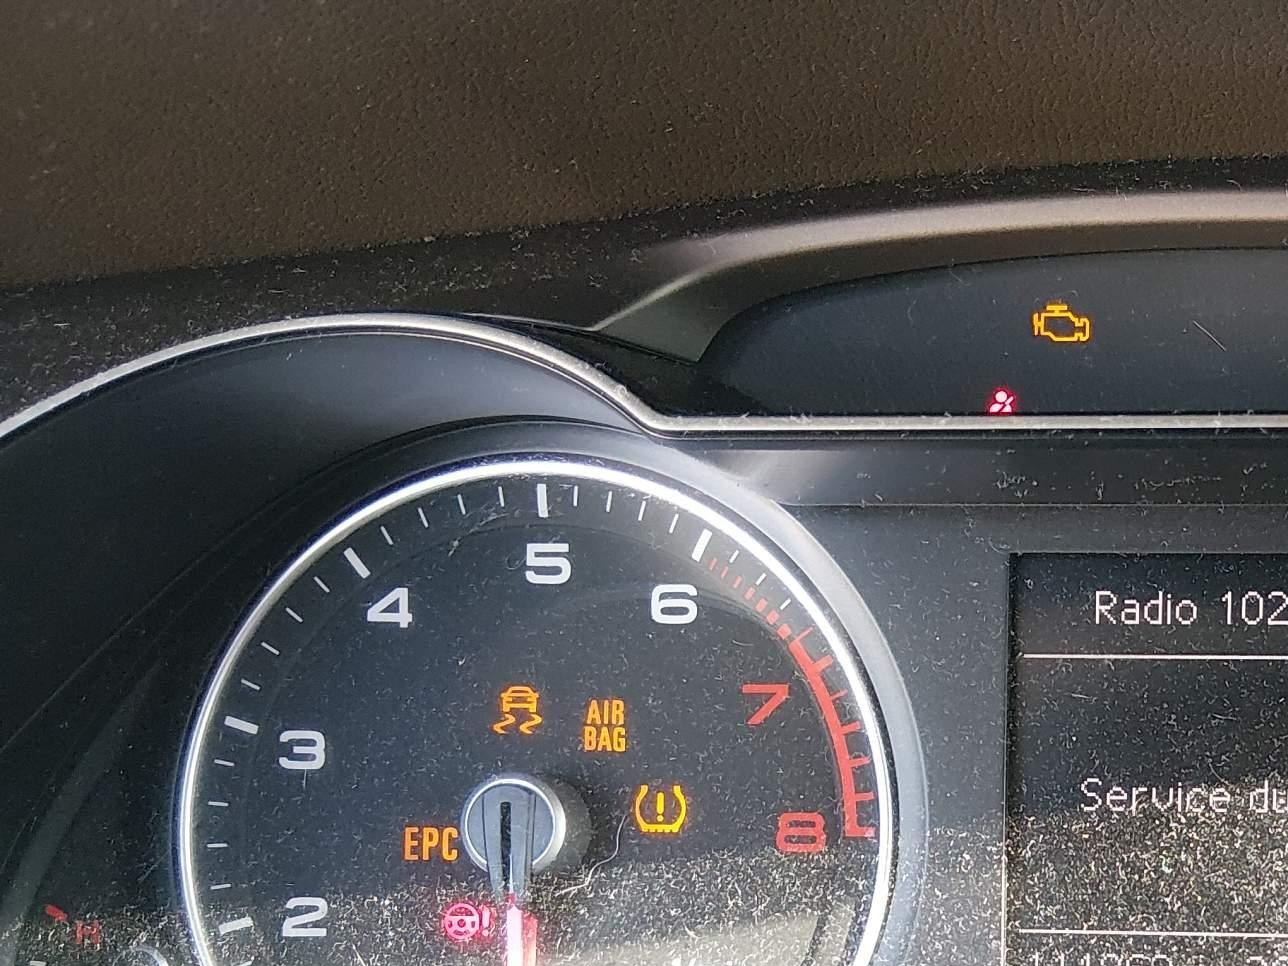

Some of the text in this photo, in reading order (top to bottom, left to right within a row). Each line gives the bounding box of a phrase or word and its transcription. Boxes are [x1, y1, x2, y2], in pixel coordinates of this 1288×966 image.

[525, 543, 572, 584] 5
[366, 587, 413, 628] 4
[651, 584, 699, 626] 6
[1094, 589, 1198, 627] Radio
[586, 699, 625, 725] AIR
[741, 683, 791, 726] 7
[279, 729, 326, 771] 3
[584, 726, 627, 753] BAG
[1080, 777, 1231, 816] Service
[404, 826, 459, 861] EPC
[775, 811, 826, 855] 8
[75, 919, 101, 944] H
[283, 897, 328, 938] 2
